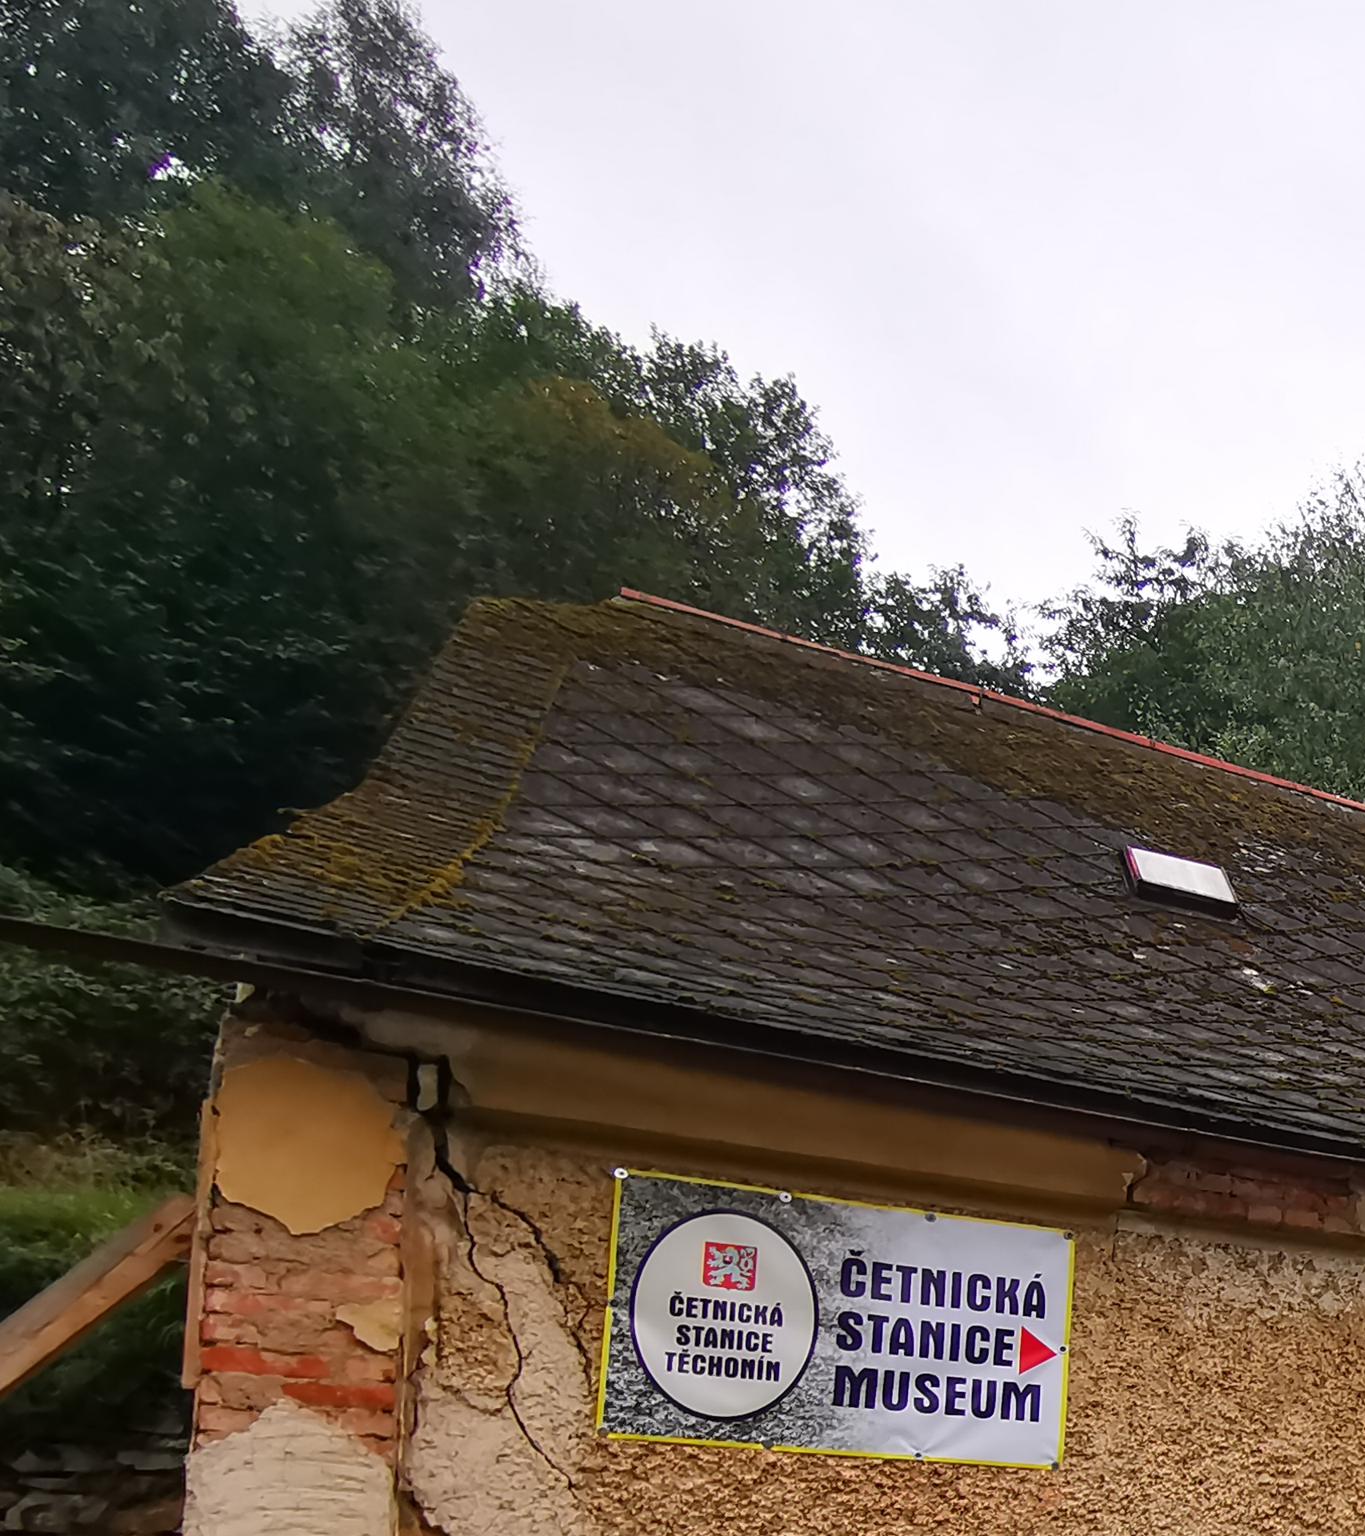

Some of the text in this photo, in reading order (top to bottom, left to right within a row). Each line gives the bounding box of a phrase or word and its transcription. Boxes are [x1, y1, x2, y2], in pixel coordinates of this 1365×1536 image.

[840, 1249, 1046, 1319] ČETNICKÁ
[669, 1291, 783, 1327] ČETNICKÁ
[676, 1324, 773, 1353] STANICE
[836, 1311, 1015, 1367] STANICE
[665, 1349, 780, 1382] TĚCHONÍN
[832, 1365, 1041, 1422] MUSEUM
